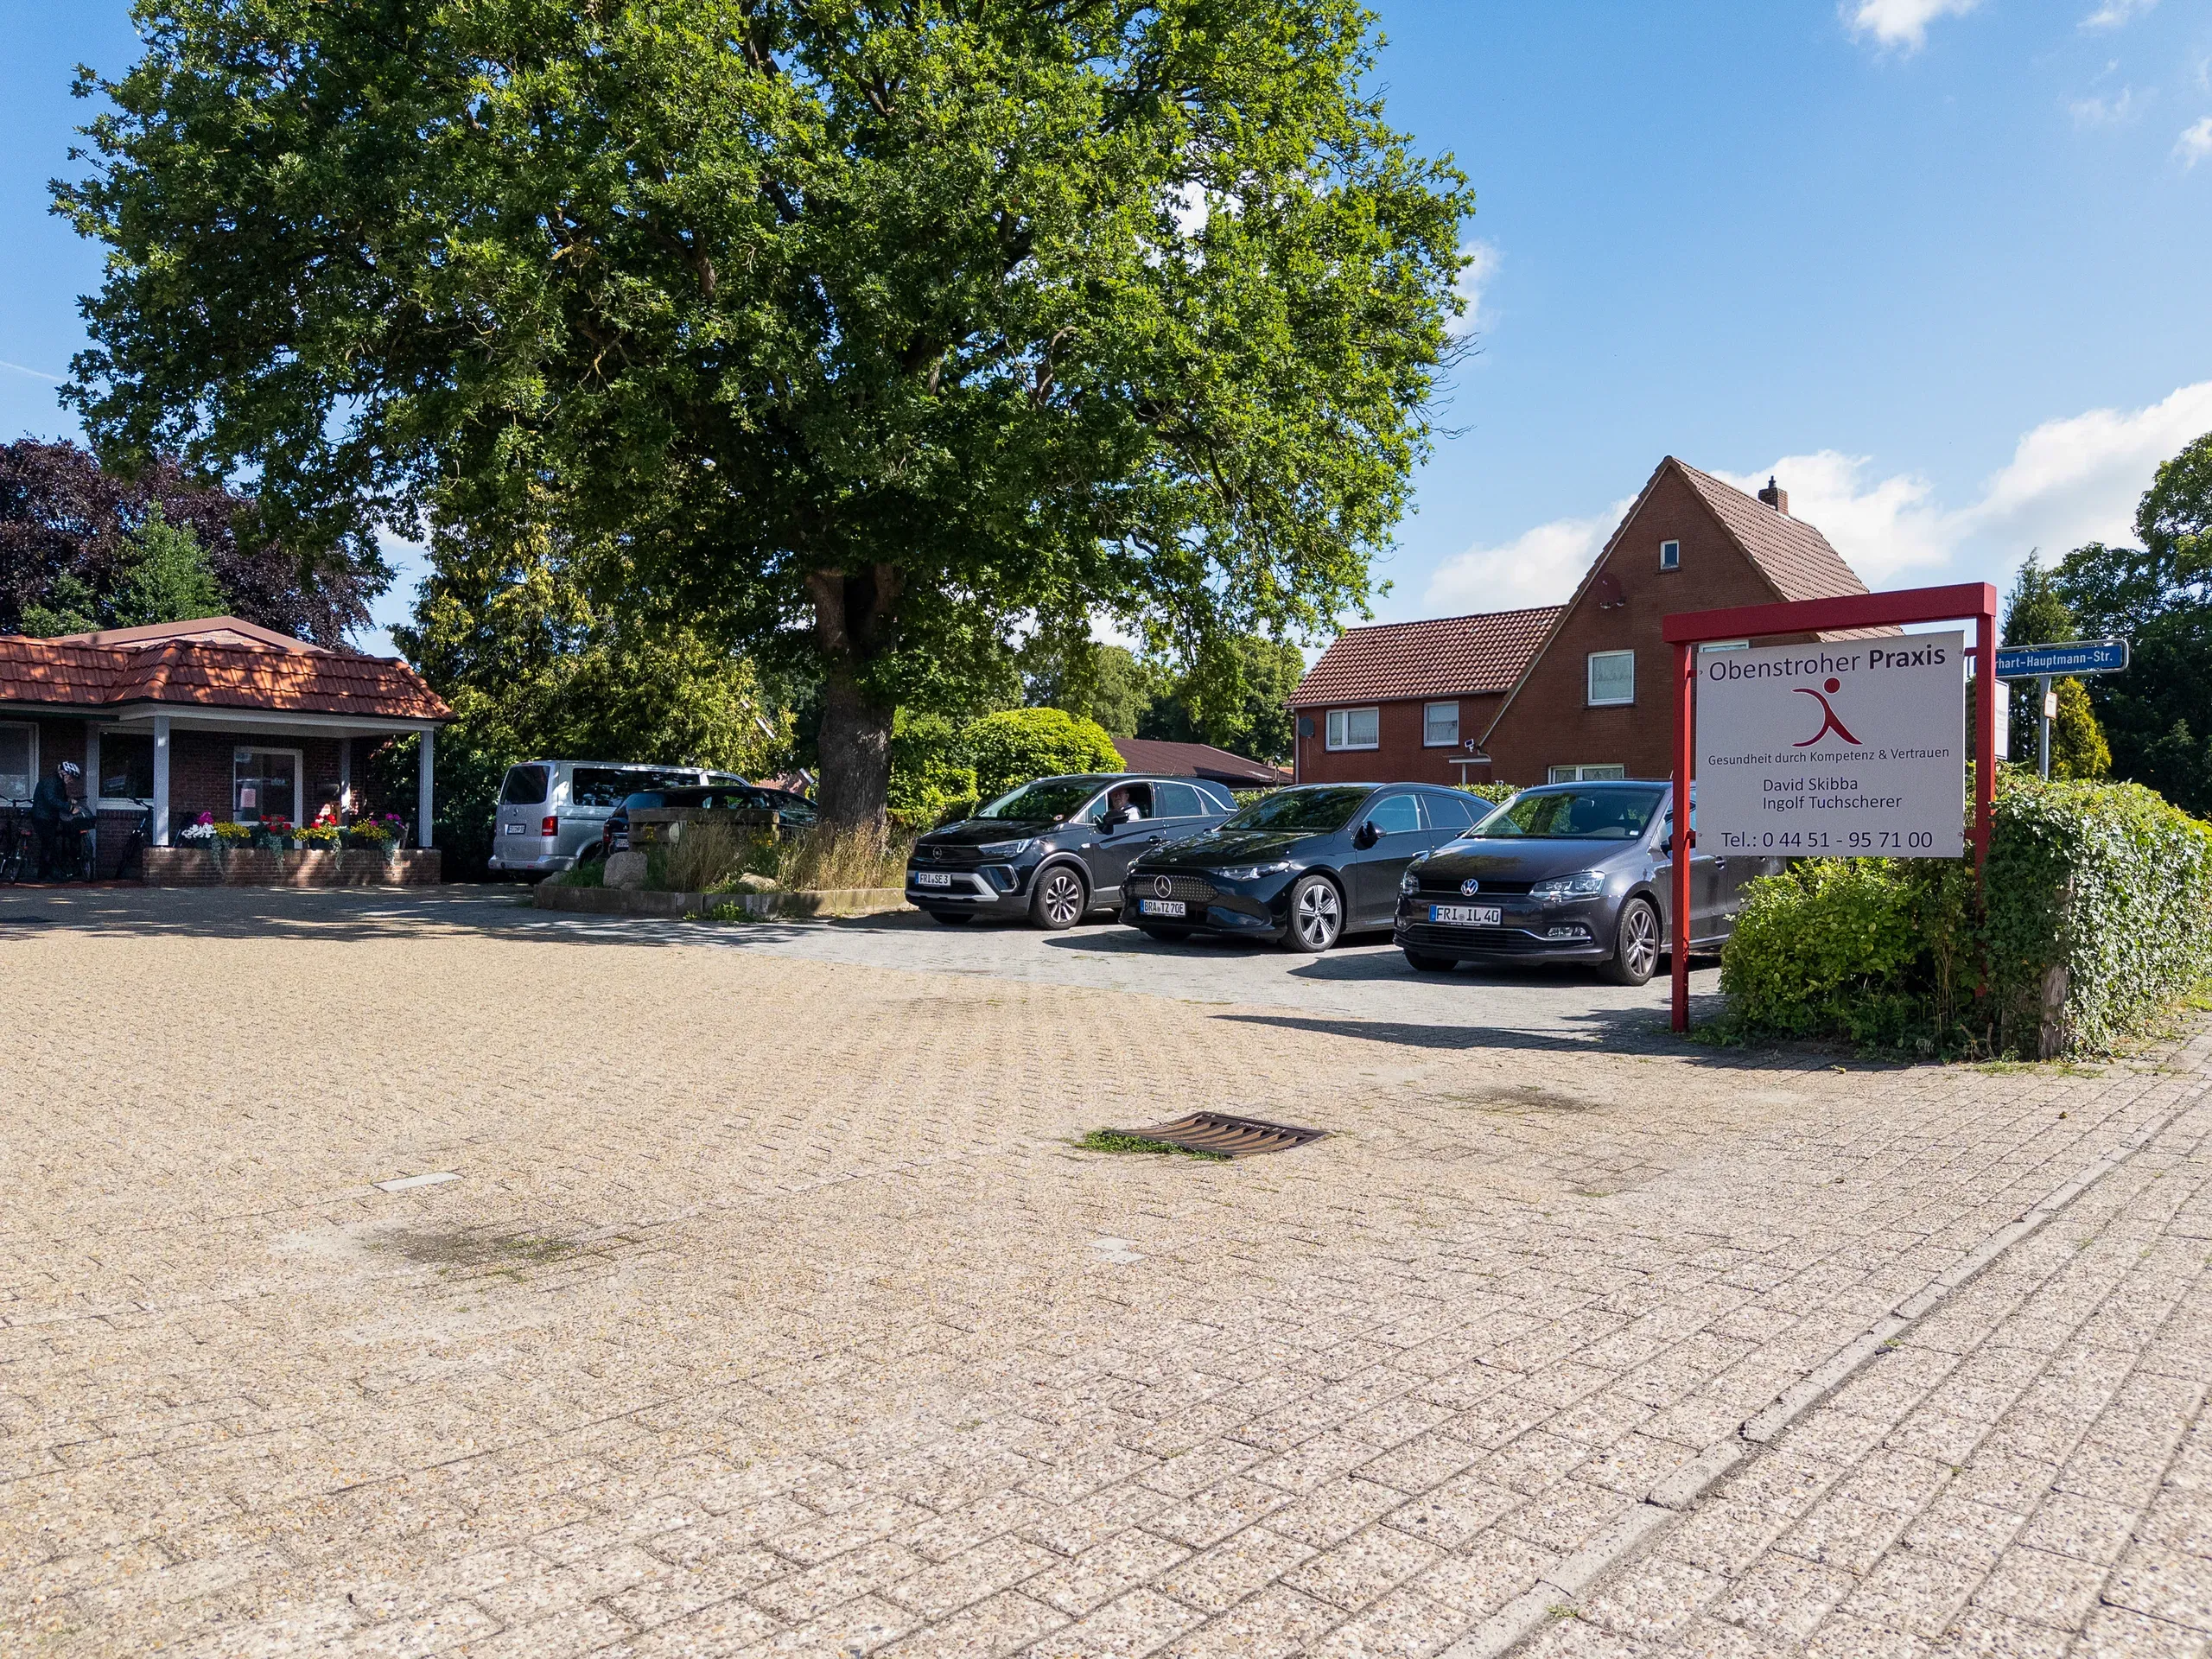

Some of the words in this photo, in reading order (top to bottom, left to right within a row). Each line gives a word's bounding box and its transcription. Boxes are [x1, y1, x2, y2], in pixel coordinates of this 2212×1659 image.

[1709, 652, 1860, 681] Obenstroher
[1869, 644, 1946, 670] Praxis
[1708, 753, 1772, 766] Gesundheit
[1775, 752, 1807, 763] durch
[1810, 751, 1875, 764] Kompetenz
[1878, 749, 1887, 760] &
[1891, 748, 1949, 759] Vertrauen
[1764, 778, 1804, 791] David
[1808, 777, 1858, 791] Skibba
[1764, 795, 1805, 812] Ingolf
[1808, 795, 1903, 809] Tuchscherer
[1720, 831, 1757, 848] Tel.:
[1763, 832, 1774, 848] 0
[1779, 832, 1802, 848] 44
[1807, 832, 1830, 848] 51
[1848, 832, 1872, 848] 95
[1878, 832, 1901, 848] 71
[1908, 832, 1933, 848] 00
[919, 874, 931, 883] FRI
[934, 874, 943, 884] SE
[1144, 901, 1157, 912] BRA
[1160, 902, 1170, 913] TZ
[1170, 903, 1184, 914] 70E
[1436, 907, 1458, 920] FRI
[1466, 908, 1481, 922] IL
[1484, 909, 1499, 923] 40
